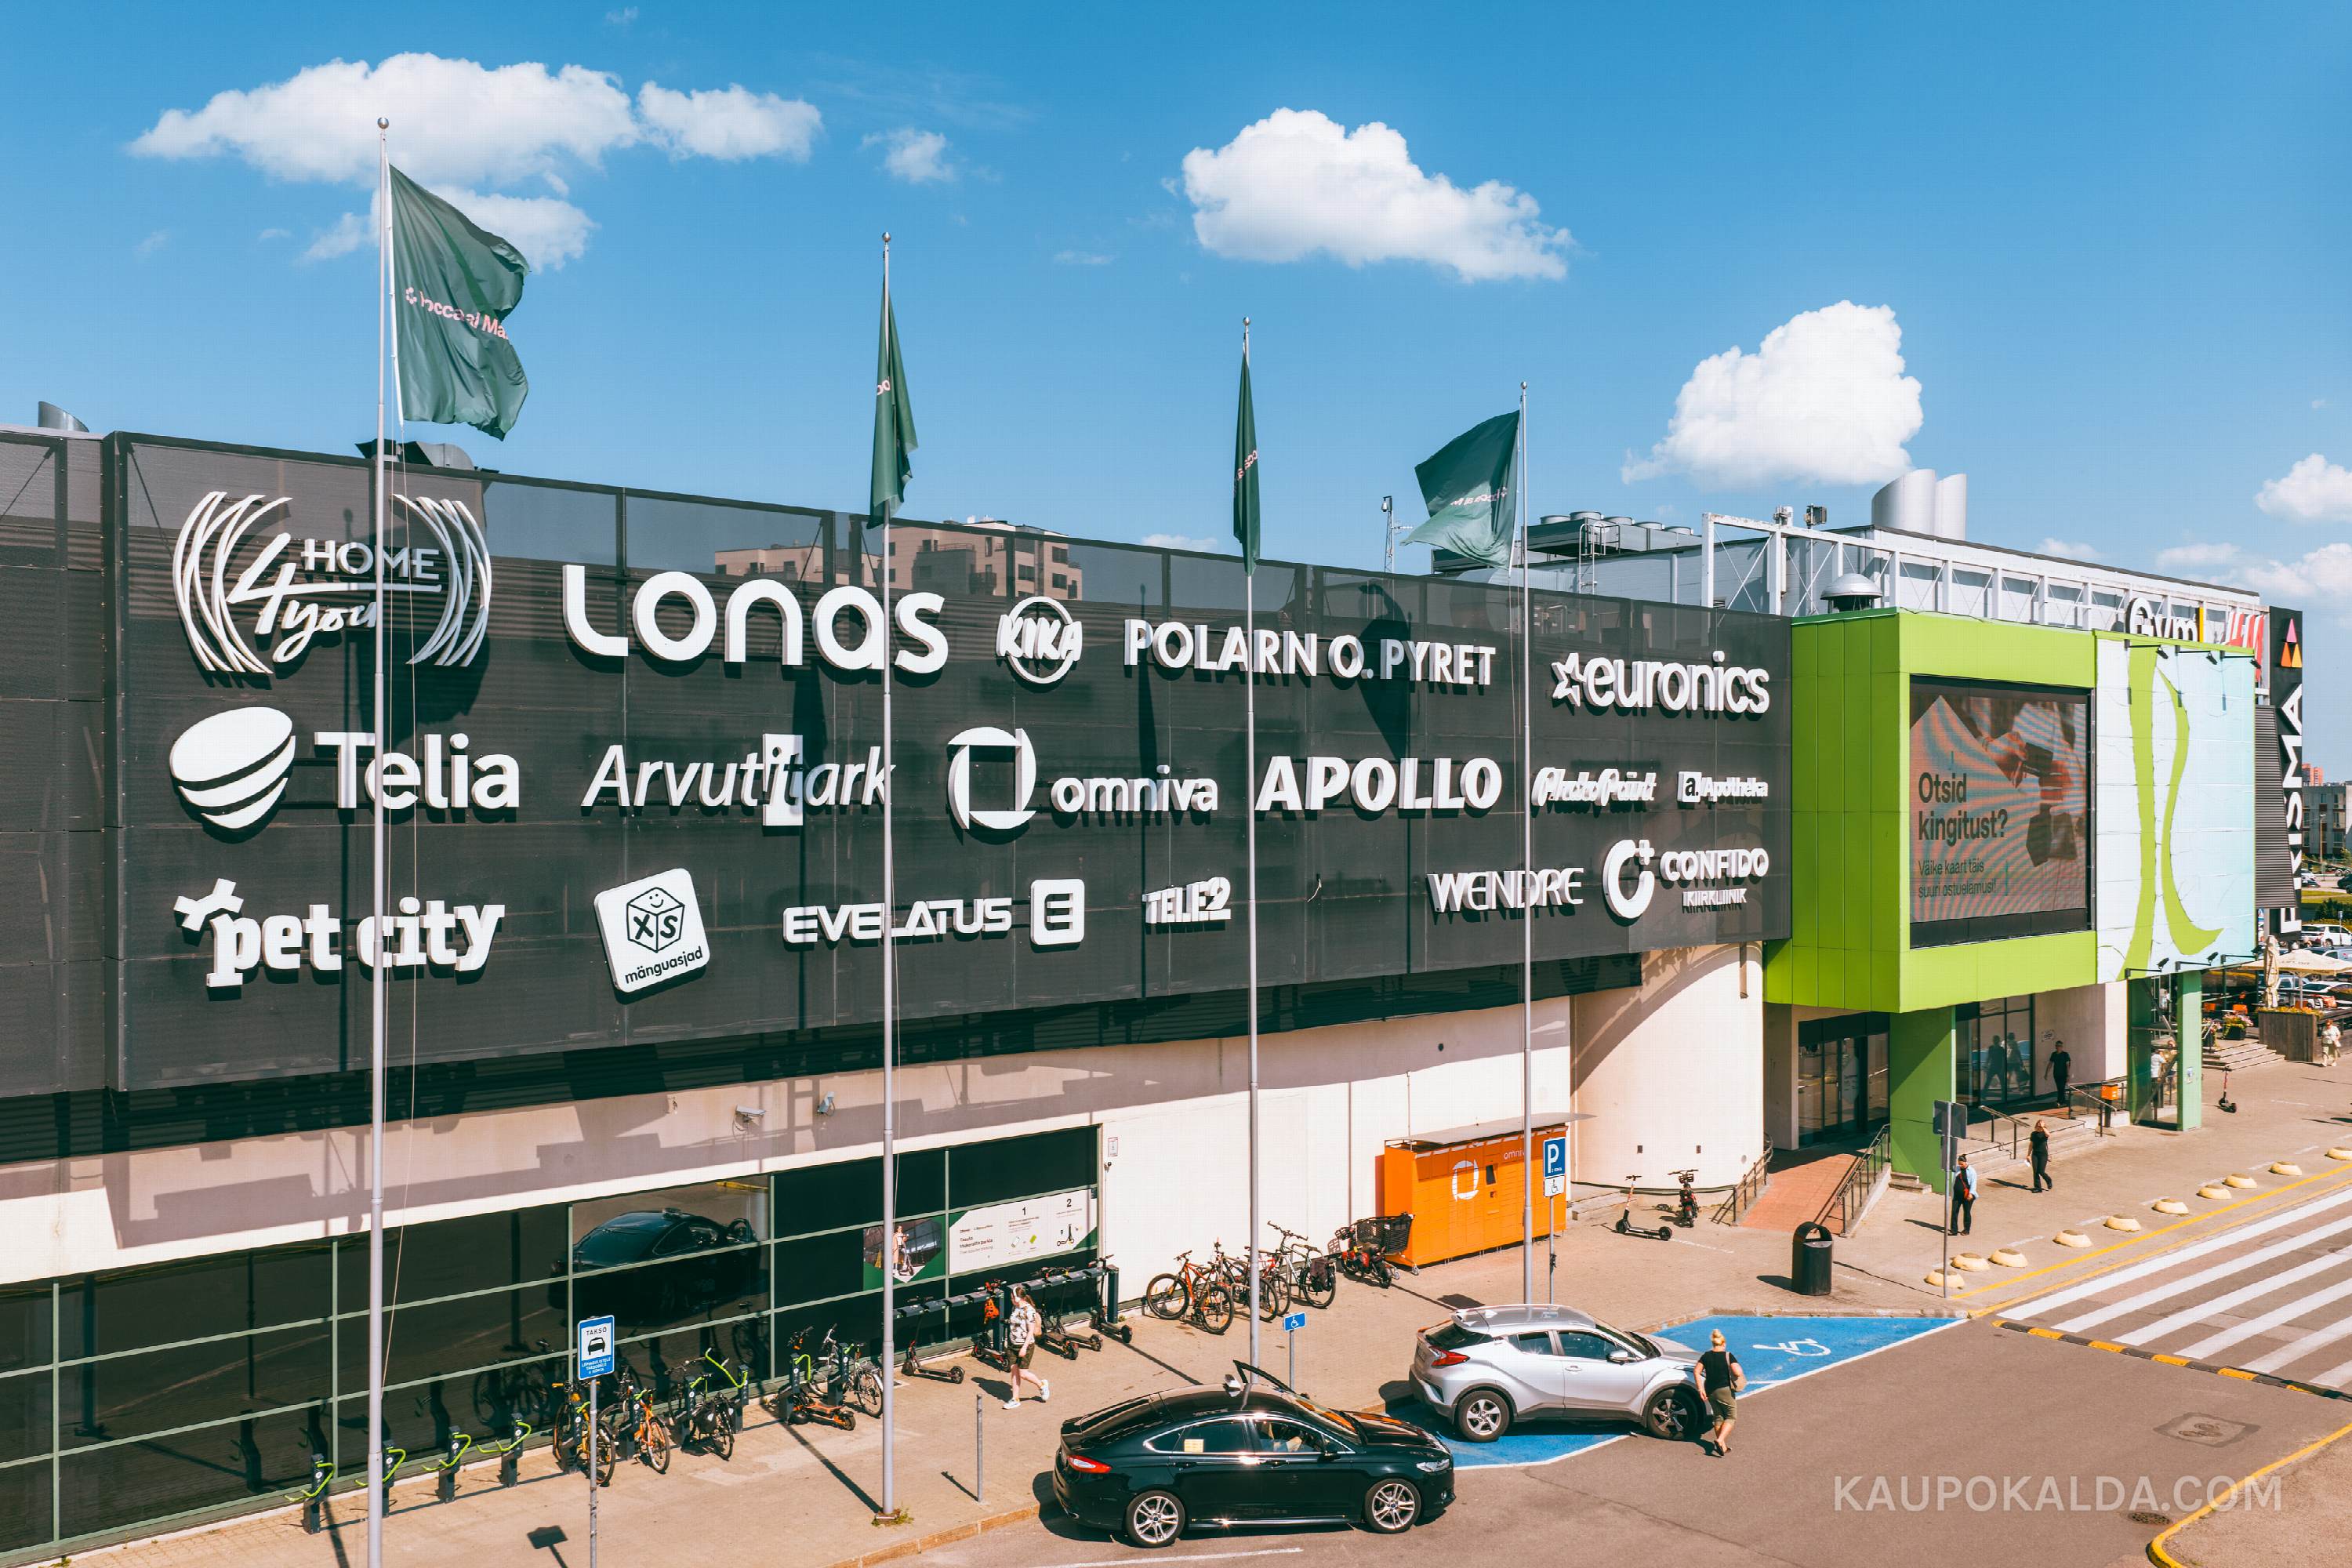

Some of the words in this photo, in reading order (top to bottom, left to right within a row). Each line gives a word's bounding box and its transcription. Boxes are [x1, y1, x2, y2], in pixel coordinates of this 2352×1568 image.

[481, 314, 509, 340] Ma
[301, 539, 440, 579] HOME
[272, 599, 377, 663] you
[562, 564, 949, 673] Lonas
[996, 614, 1083, 662] KIKA
[1124, 619, 1318, 677] POLARN
[1328, 634, 1374, 680] O.
[1380, 638, 1496, 685] PYRET
[1584, 650, 1769, 713] euronics
[314, 731, 520, 810] Telia
[1051, 764, 1218, 813] omniva
[1254, 755, 1502, 812] APOLLO
[1918, 771, 1967, 804] Otsid
[1918, 808, 2008, 847] kingitust?
[1661, 848, 1769, 881] CONFIDO
[1918, 859, 1943, 877] Väike
[1944, 859, 1967, 875] kaart
[1142, 877, 1231, 924] TELE2
[1427, 867, 1584, 913] WENDRE
[1918, 883, 1941, 898] suuri
[783, 897, 1012, 943] EVELATUS
[206, 913, 342, 987] pet
[357, 896, 505, 972] city
[625, 946, 703, 984] mänguasjad
[1504, 1147, 1525, 1160] omniv
[1548, 1143, 1559, 1174] P
[1022, 1207, 1026, 1216] 1
[1066, 1198, 1072, 1208] 2
[586, 1327, 607, 1336] TAKSO
